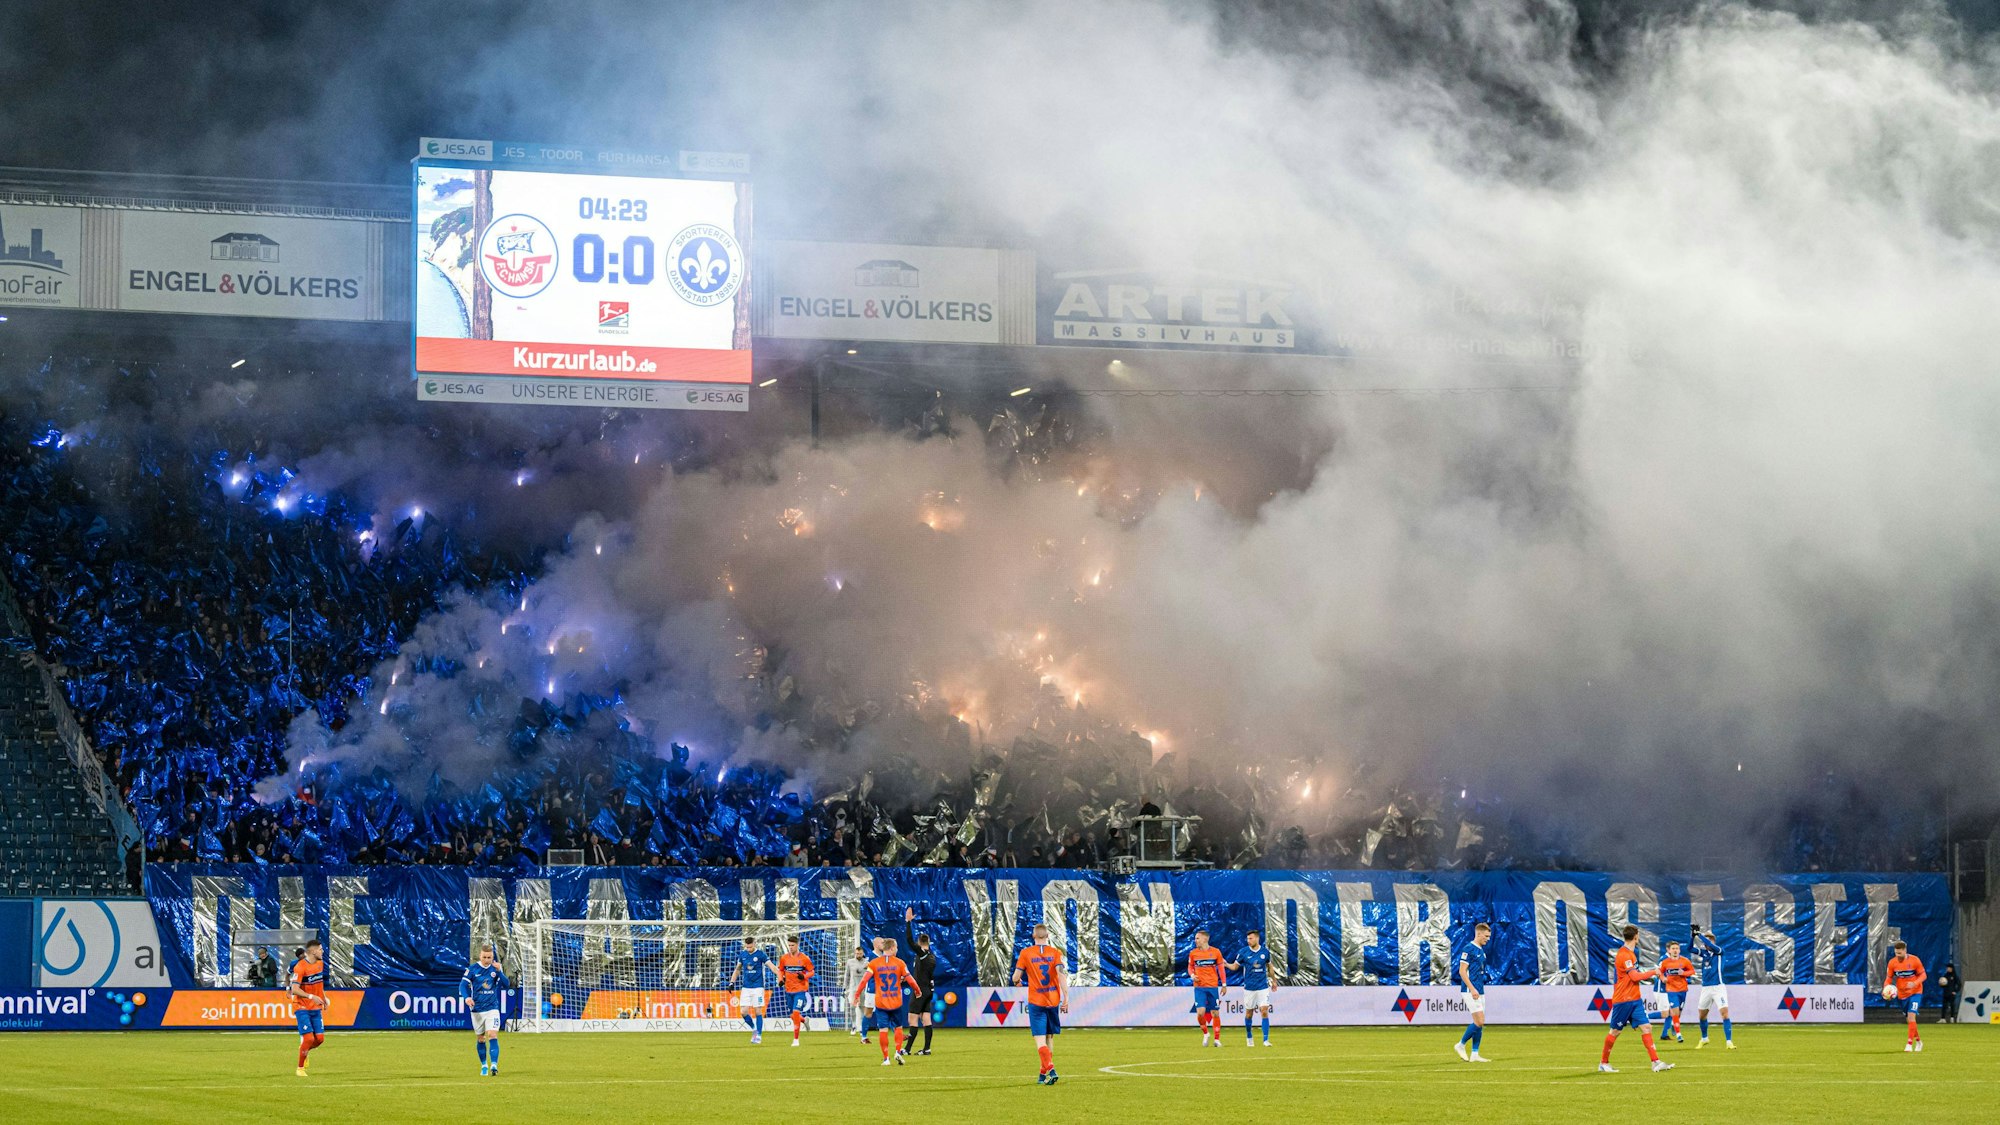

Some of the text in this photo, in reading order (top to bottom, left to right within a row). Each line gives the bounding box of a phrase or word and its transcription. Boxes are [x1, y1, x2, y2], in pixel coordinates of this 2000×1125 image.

[441, 144, 486, 156] JES.AG
[626, 152, 671, 165] HANSA
[579, 197, 648, 221] 04:23
[675, 227, 733, 249] SPORTVEREIN
[572, 233, 655, 285] 0:0
[669, 269, 714, 303] DARMSTADT
[1054, 282, 1295, 326] ARTEK
[1062, 324, 1288, 344] MASSIVHAUS
[513, 346, 657, 373] Kurzurlaub.de
[440, 383, 485, 396] JES.AG
[512, 383, 579, 400] UNSERE
[700, 391, 744, 404] JES.AG
[191, 875, 1902, 993] DIE MACHT VON DER OSTSEE
[878, 972, 899, 992] 32
[1038, 964, 1051, 987] 3
[231, 997, 297, 1019] immu
[1225, 1000, 1244, 1013] Tele
[1425, 998, 1470, 1012] Tele Medi
[1810, 997, 1855, 1010] Tele Media
[0, 1018, 43, 1028] olekular
[389, 1018, 466, 1027] orthomolekular
[582, 1020, 620, 1031] APEX
[645, 1020, 682, 1030] APEX
